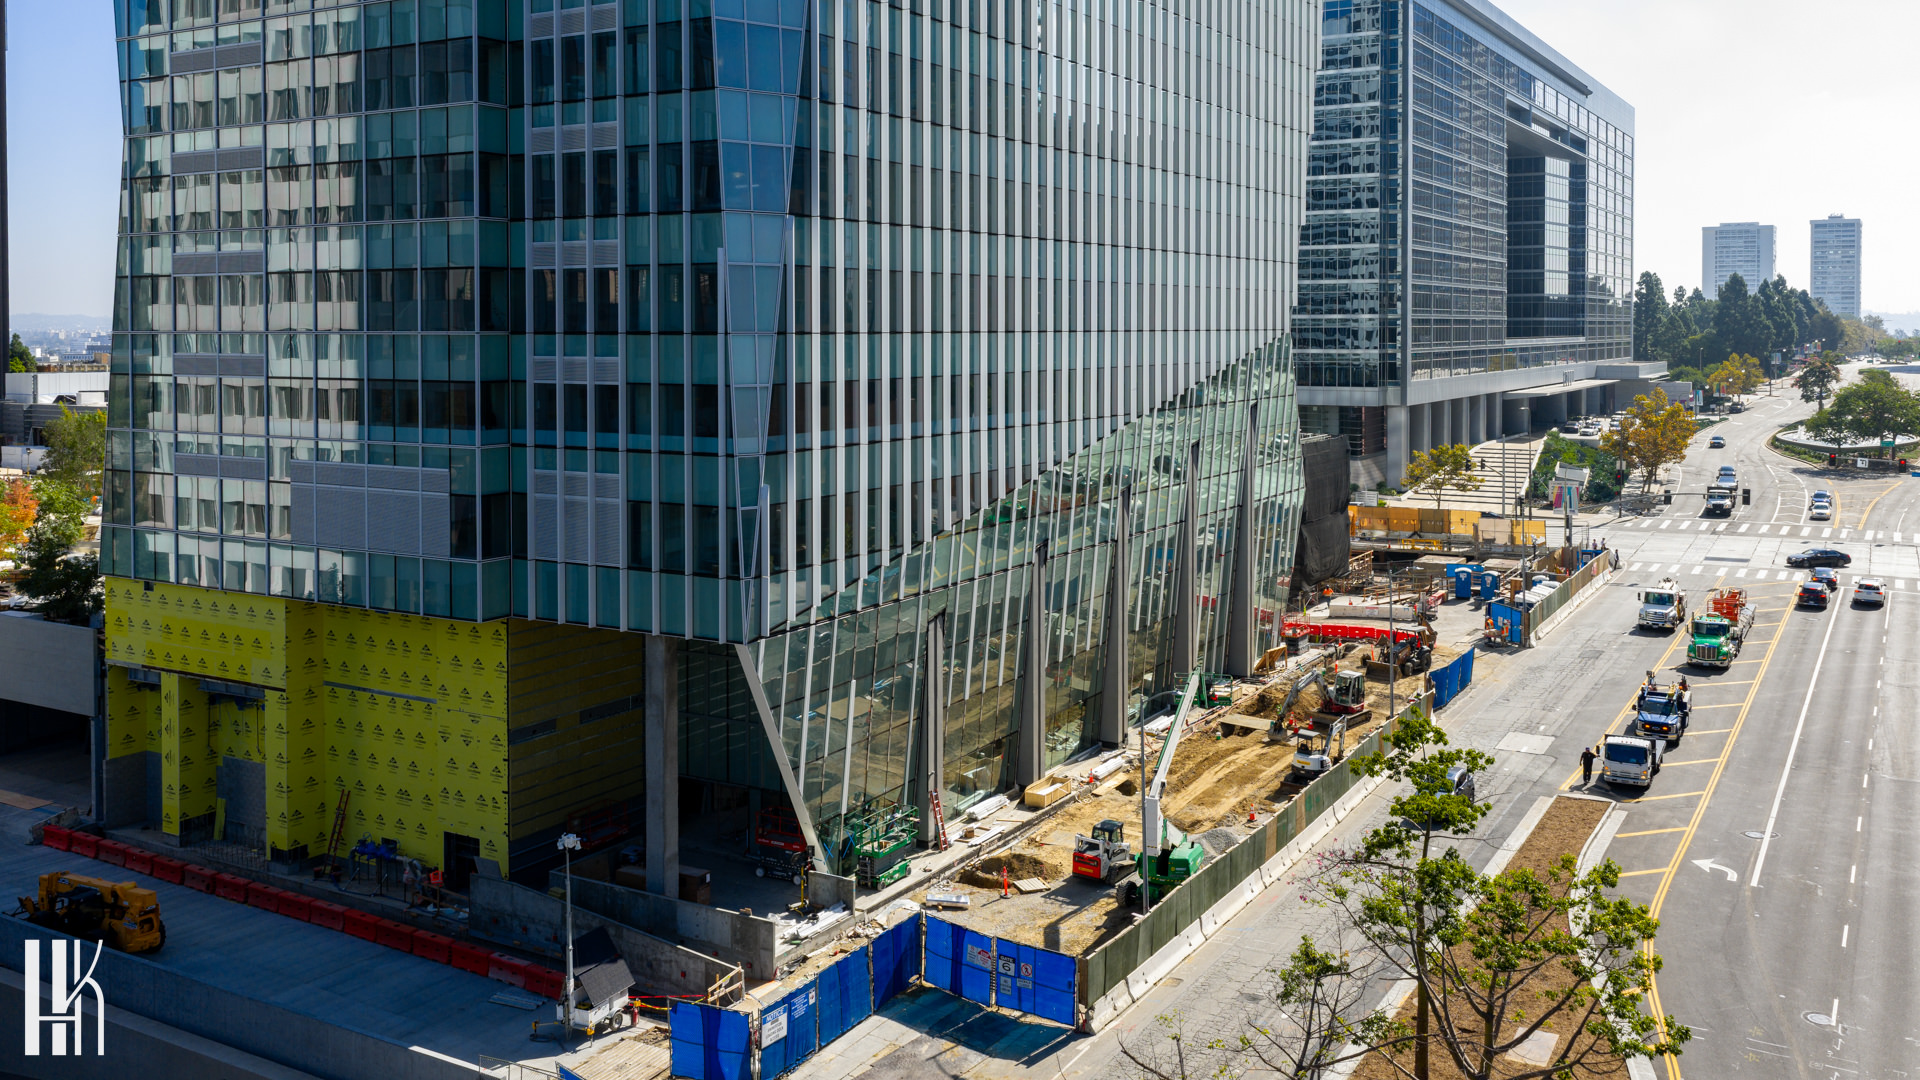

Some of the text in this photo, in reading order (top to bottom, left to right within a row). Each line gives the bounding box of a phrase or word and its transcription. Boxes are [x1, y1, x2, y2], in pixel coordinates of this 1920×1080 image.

[1000, 955, 1013, 963] GATE
[1002, 962, 1011, 972] 6
[766, 1007, 784, 1022] NOTICE
